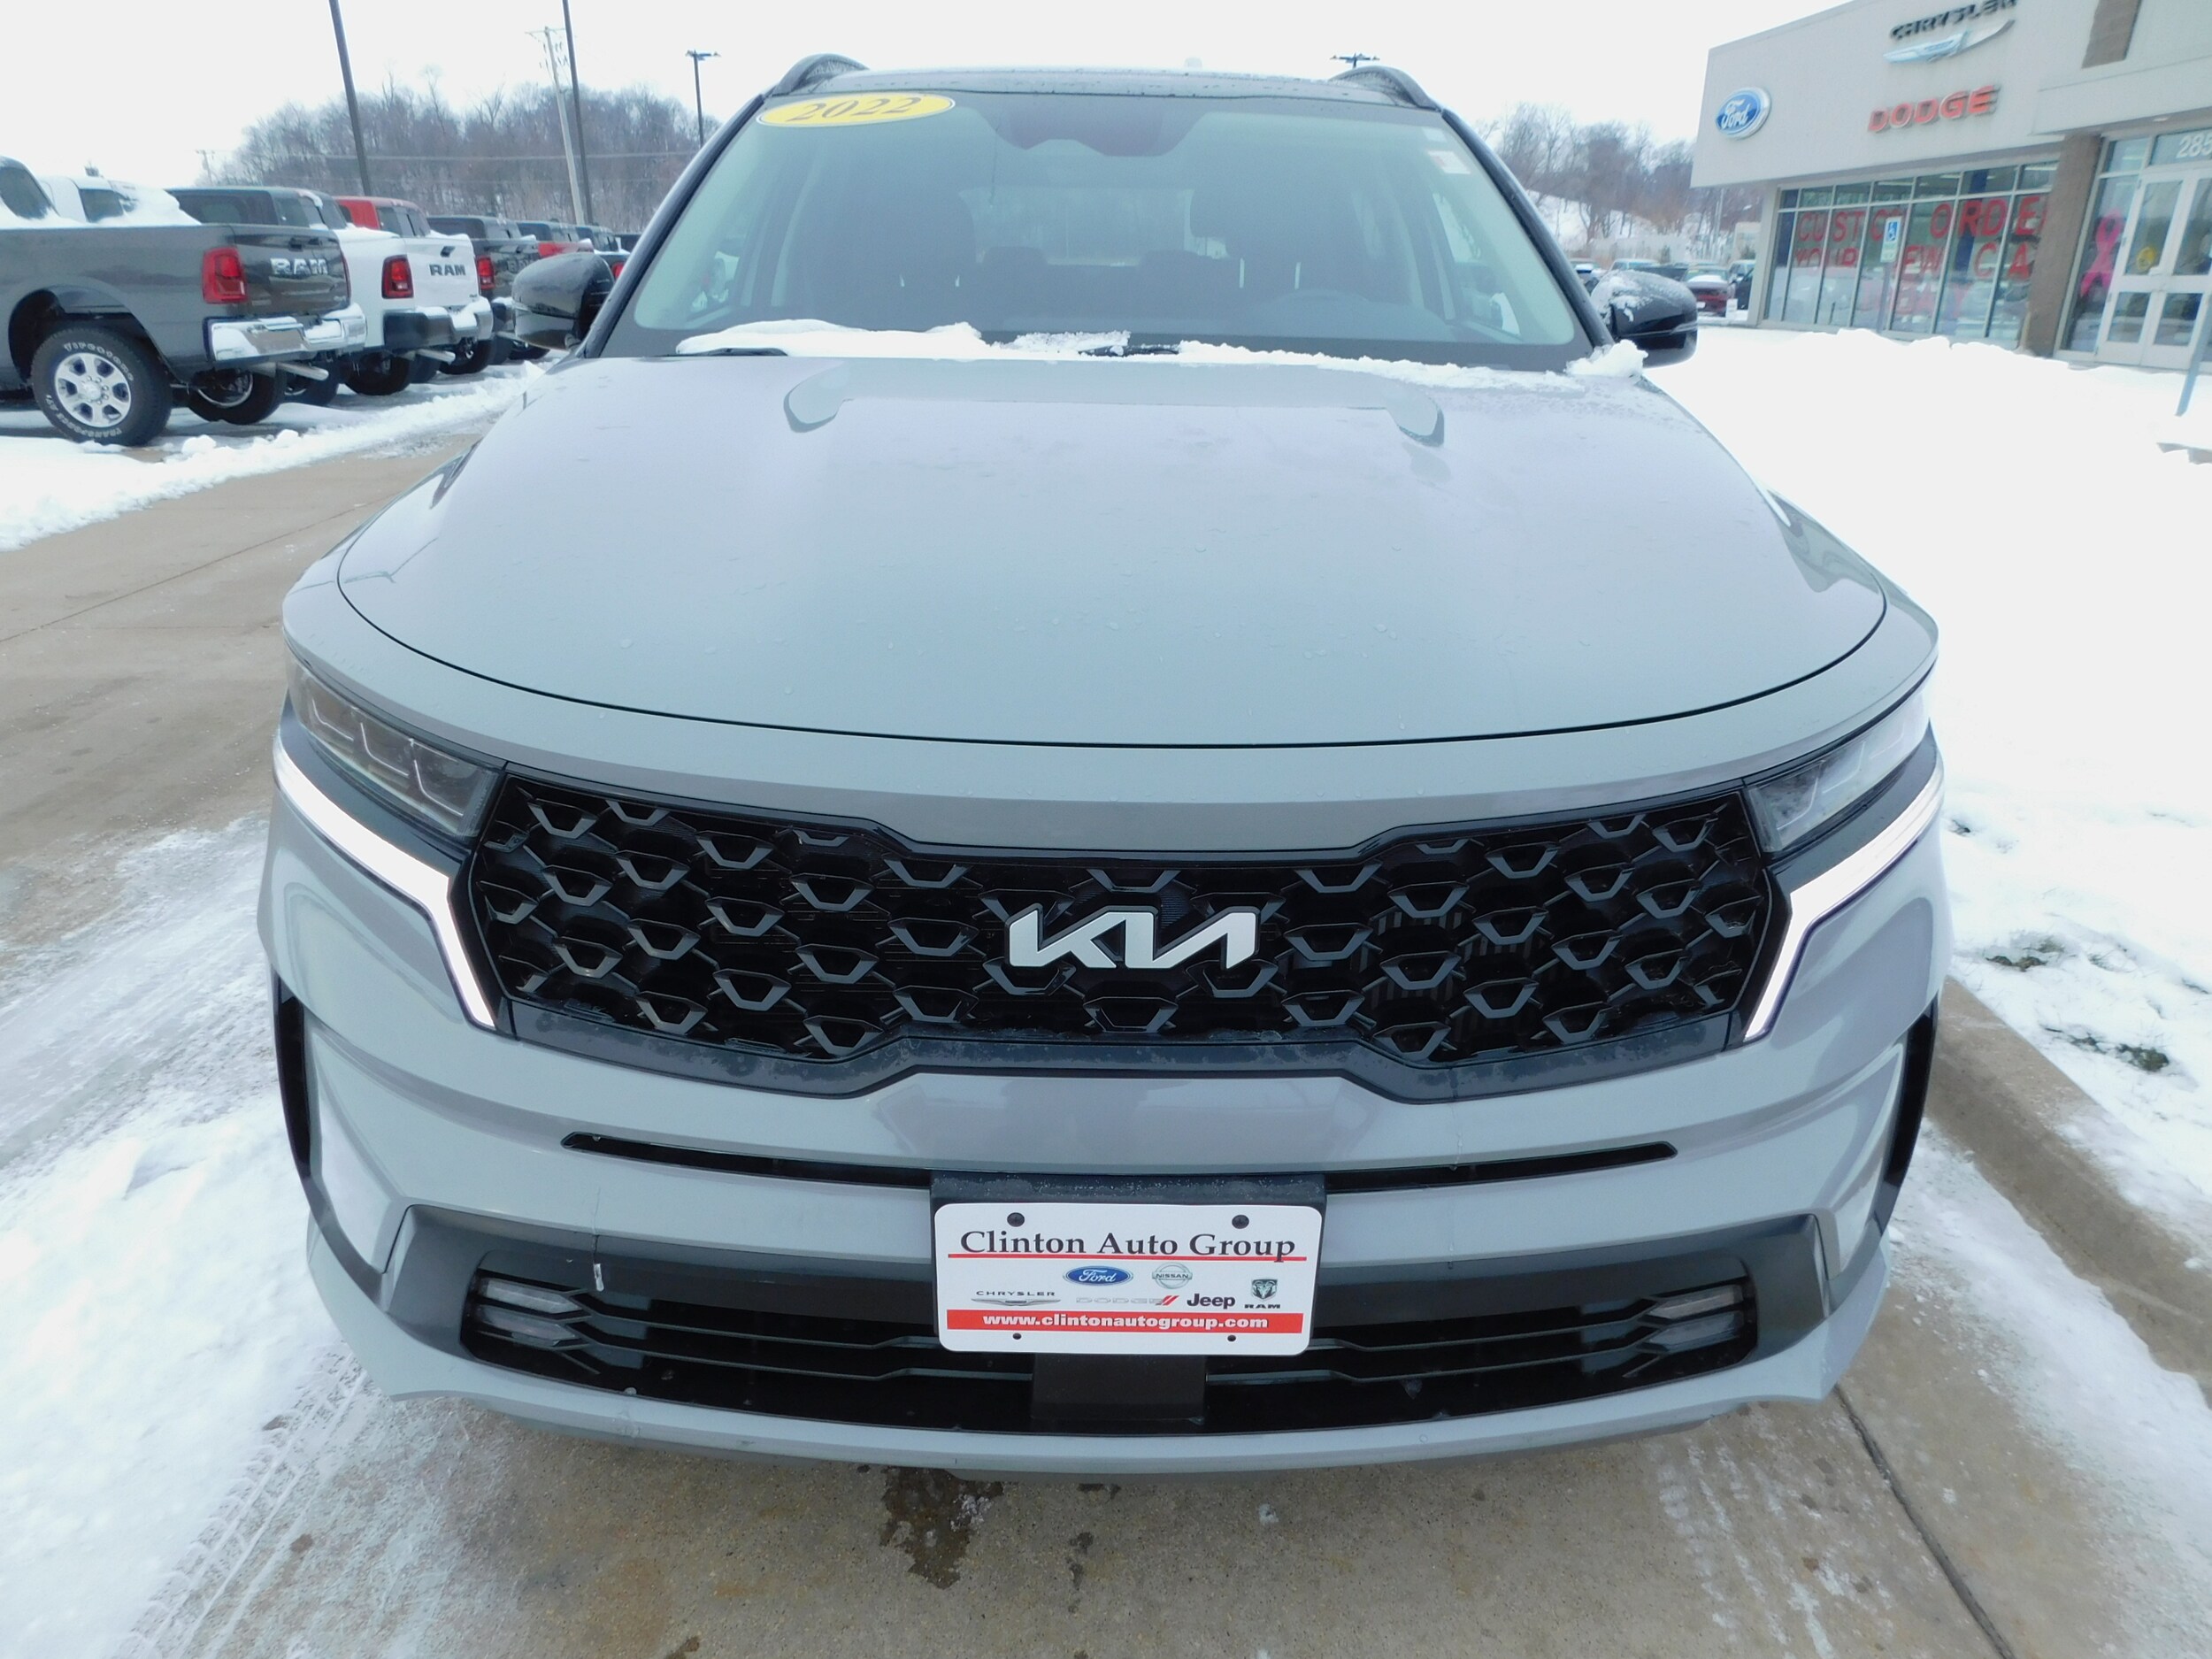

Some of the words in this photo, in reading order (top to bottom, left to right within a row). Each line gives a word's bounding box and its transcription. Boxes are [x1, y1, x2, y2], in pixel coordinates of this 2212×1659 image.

[786, 96, 921, 122] 2022
[1867, 85, 2001, 133] DODGE
[270, 258, 329, 275] RAM
[1974, 241, 2032, 280] CA
[429, 265, 465, 276] RAM
[961, 1230, 1087, 1253] Clinton
[1097, 1233, 1178, 1255] Auto
[1189, 1233, 1295, 1263] Group
[1079, 1269, 1117, 1282] Ford
[1187, 1293, 1236, 1310] Jeep
[982, 1313, 1269, 1329] www.clintonautogroup.com
